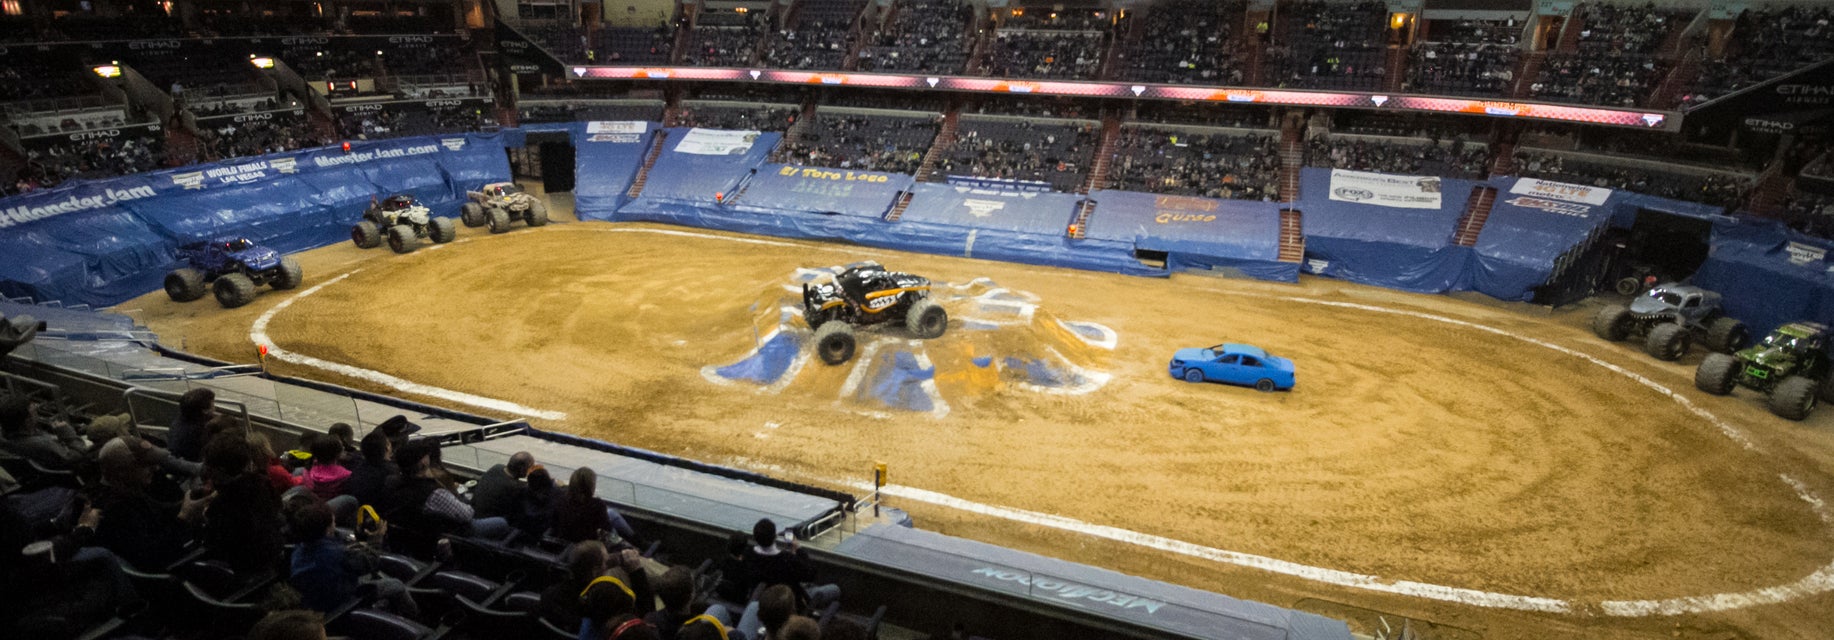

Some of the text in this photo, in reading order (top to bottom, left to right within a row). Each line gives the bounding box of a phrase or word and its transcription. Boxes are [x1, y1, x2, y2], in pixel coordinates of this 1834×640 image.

[129, 39, 181, 50] ETIHAD
[281, 37, 329, 45] ETIHAD
[389, 36, 433, 44] ETIHAD
[345, 103, 383, 113] ETIHAD
[426, 99, 462, 107] ETIHAD
[234, 112, 273, 123] ETIHAD
[1744, 118, 1794, 130] ETIHAD
[69, 128, 121, 141] ETIHAD
[206, 166, 238, 179] WORLD
[238, 161, 268, 174] FINALS
[802, 168, 841, 181] Toro
[220, 170, 266, 184] LAS VEGAS
